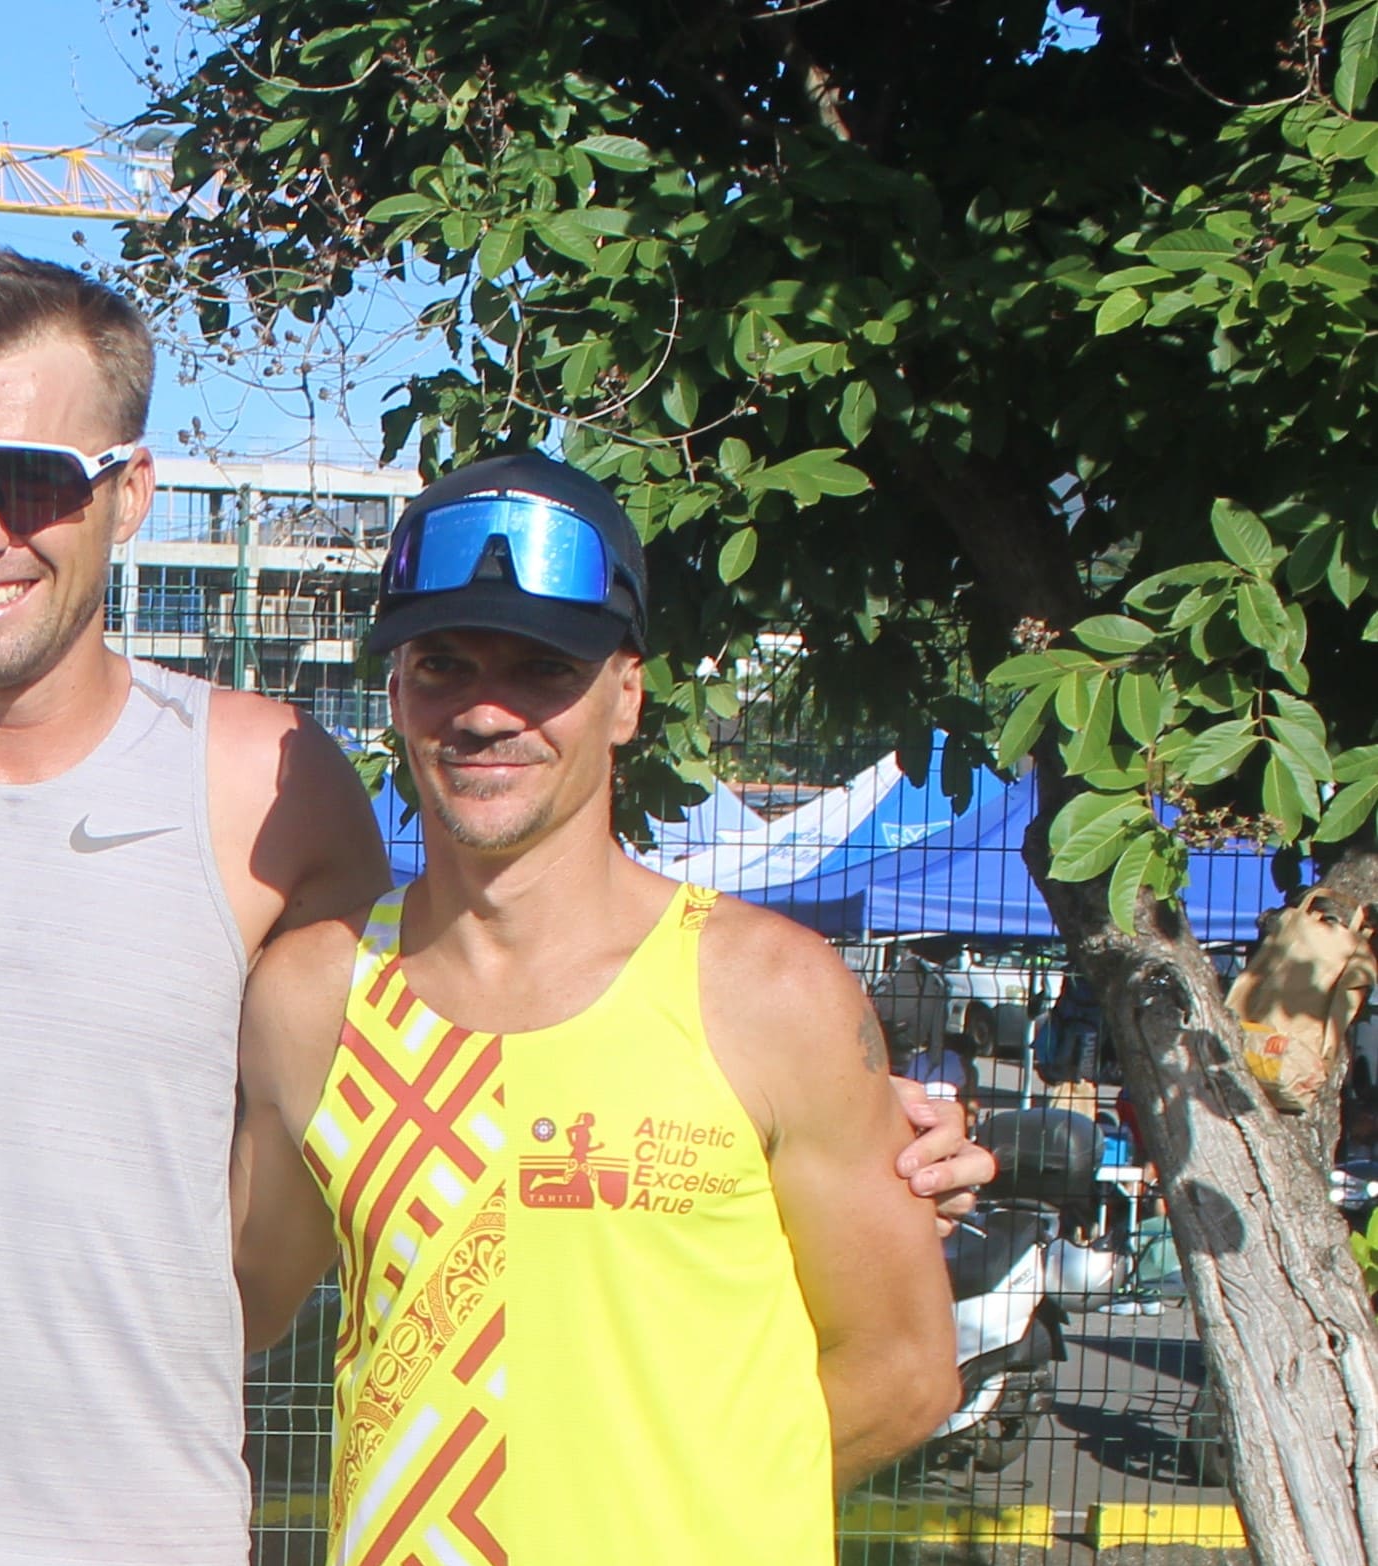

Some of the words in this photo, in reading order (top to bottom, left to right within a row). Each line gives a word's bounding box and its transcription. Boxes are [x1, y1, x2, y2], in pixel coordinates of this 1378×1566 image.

[633, 1116, 736, 1148] Athletic
[634, 1140, 698, 1168] Club
[632, 1164, 742, 1195] Excelsior
[528, 1194, 582, 1204] TAHITI
[629, 1188, 694, 1215] Arue
